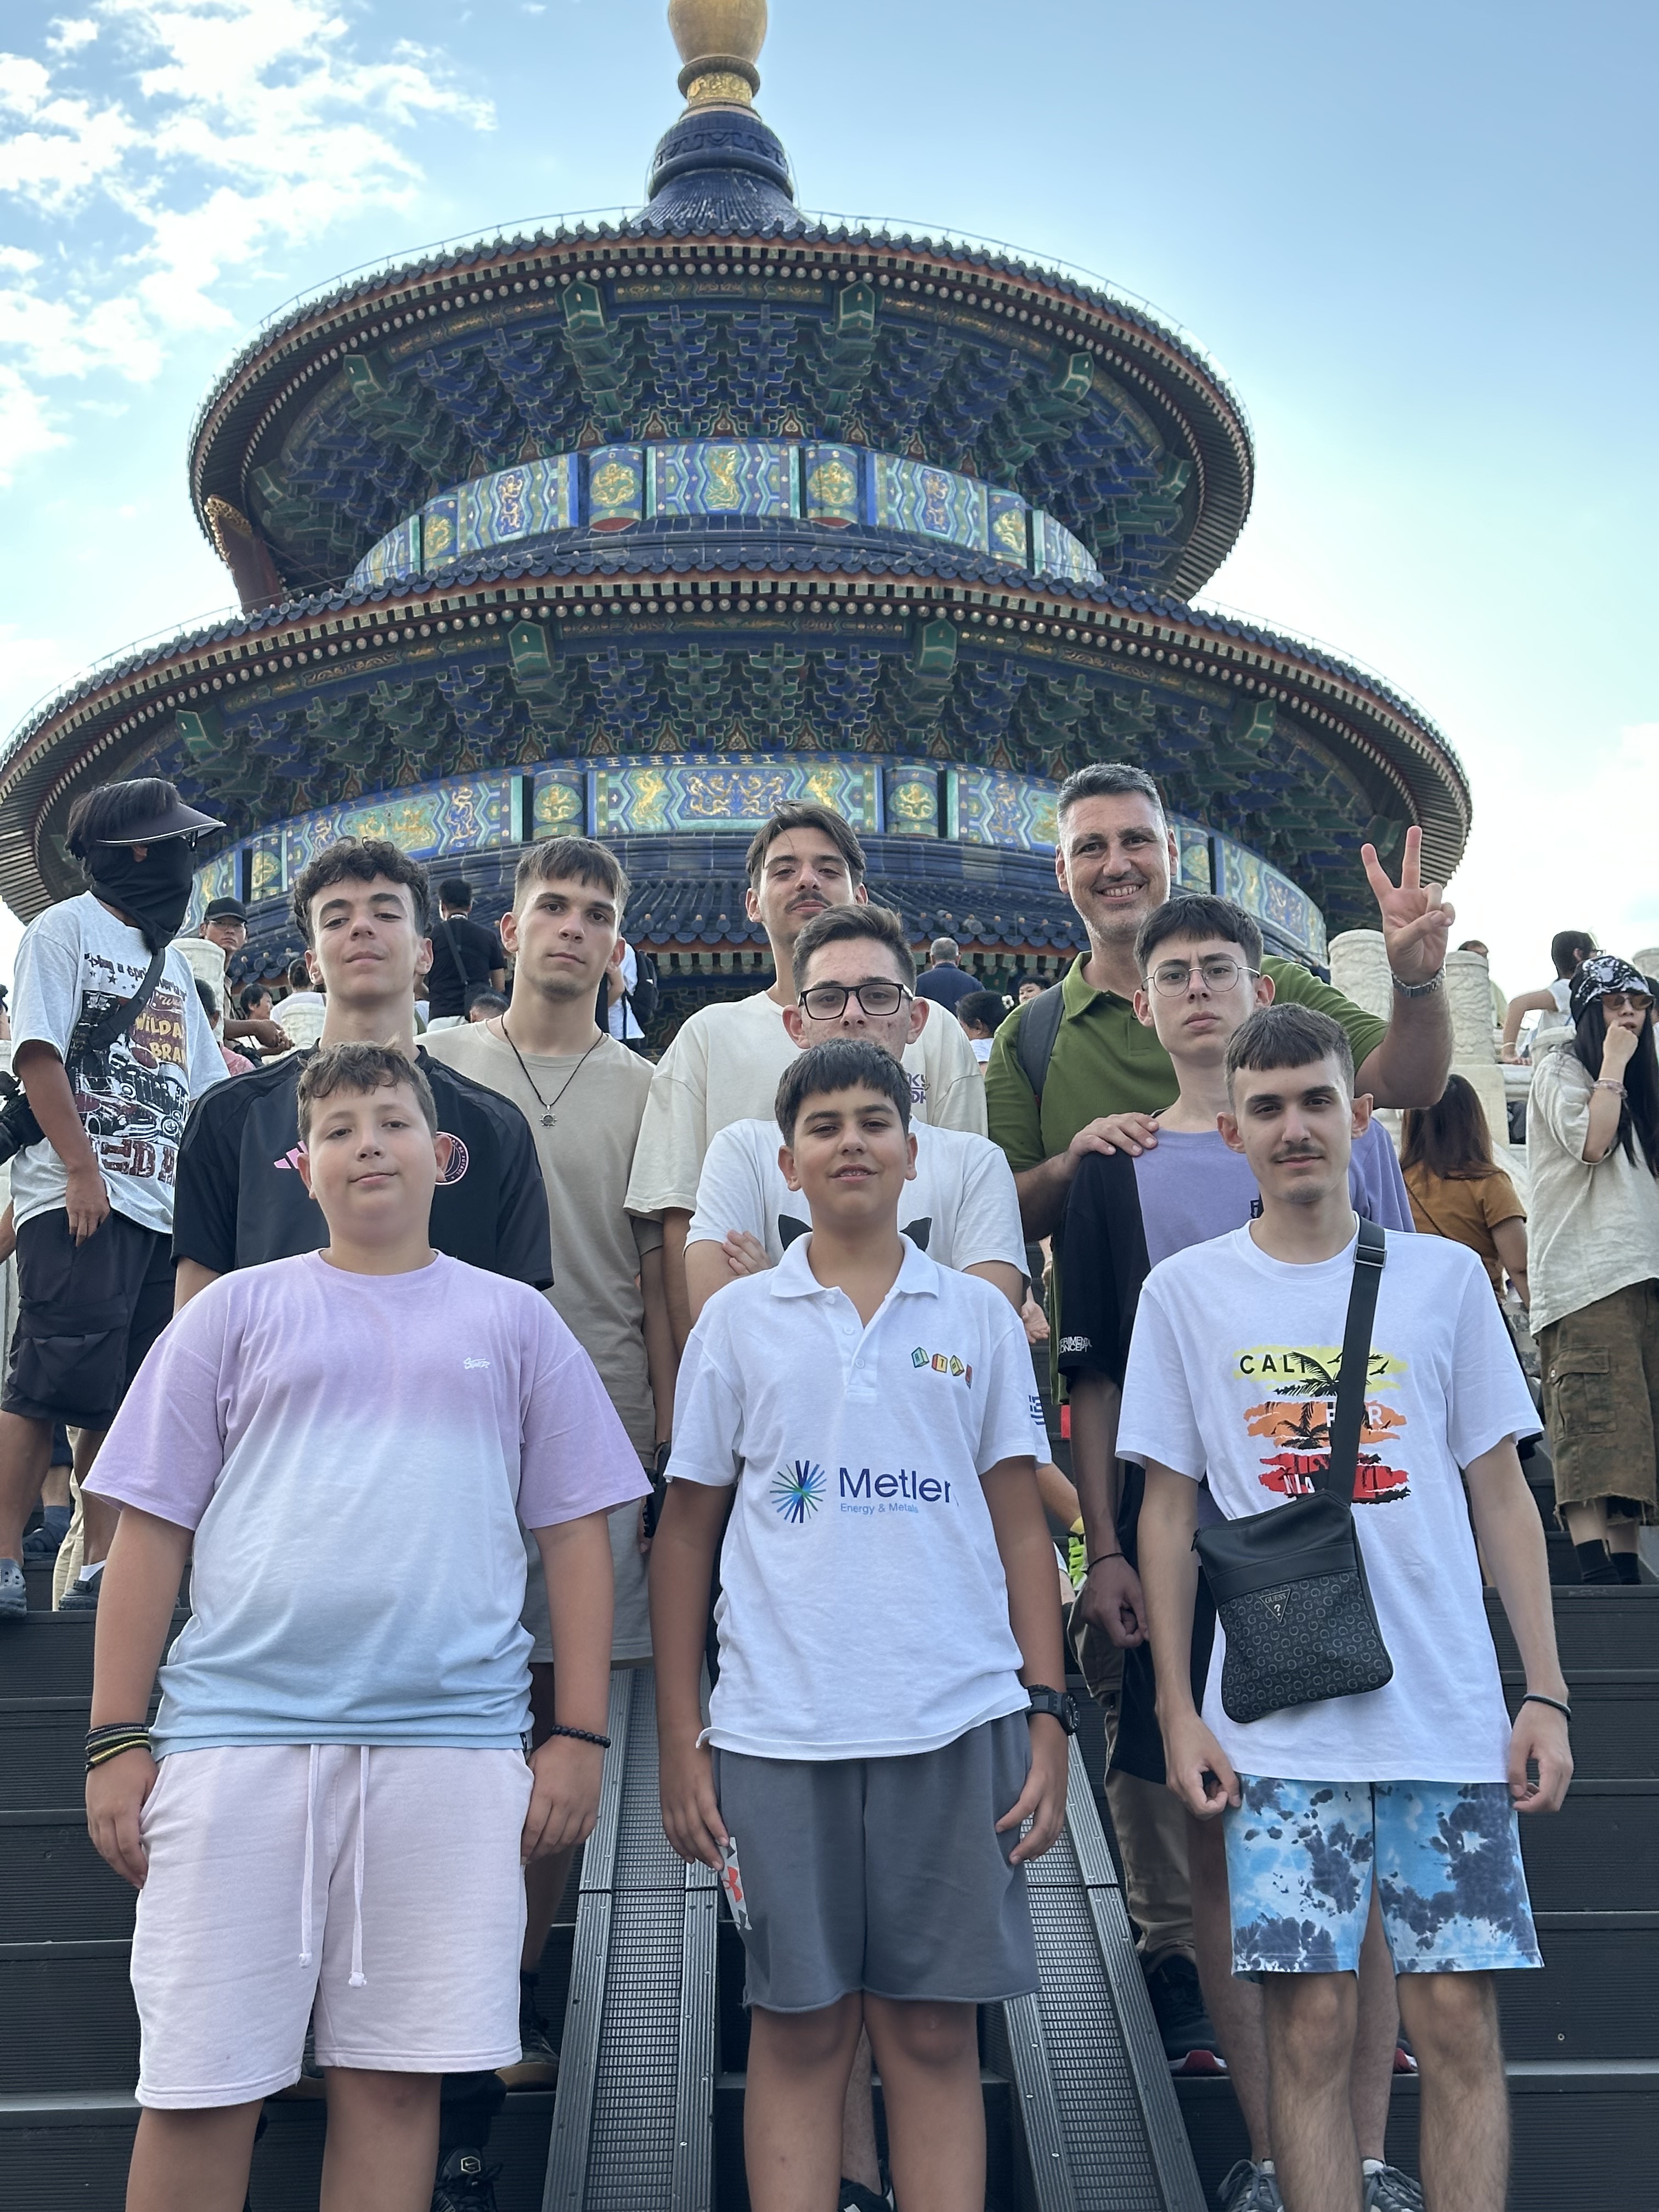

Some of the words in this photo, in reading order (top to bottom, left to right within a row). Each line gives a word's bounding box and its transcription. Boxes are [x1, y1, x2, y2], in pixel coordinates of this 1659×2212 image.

[1058, 1342, 1088, 1355] ONCEPT
[1325, 1404, 1384, 1428] FR
[840, 1503, 874, 1515] Energy
[878, 1503, 887, 1513] &
[889, 1503, 919, 1514] Metals
[1265, 1593, 1286, 1604] GUESS
